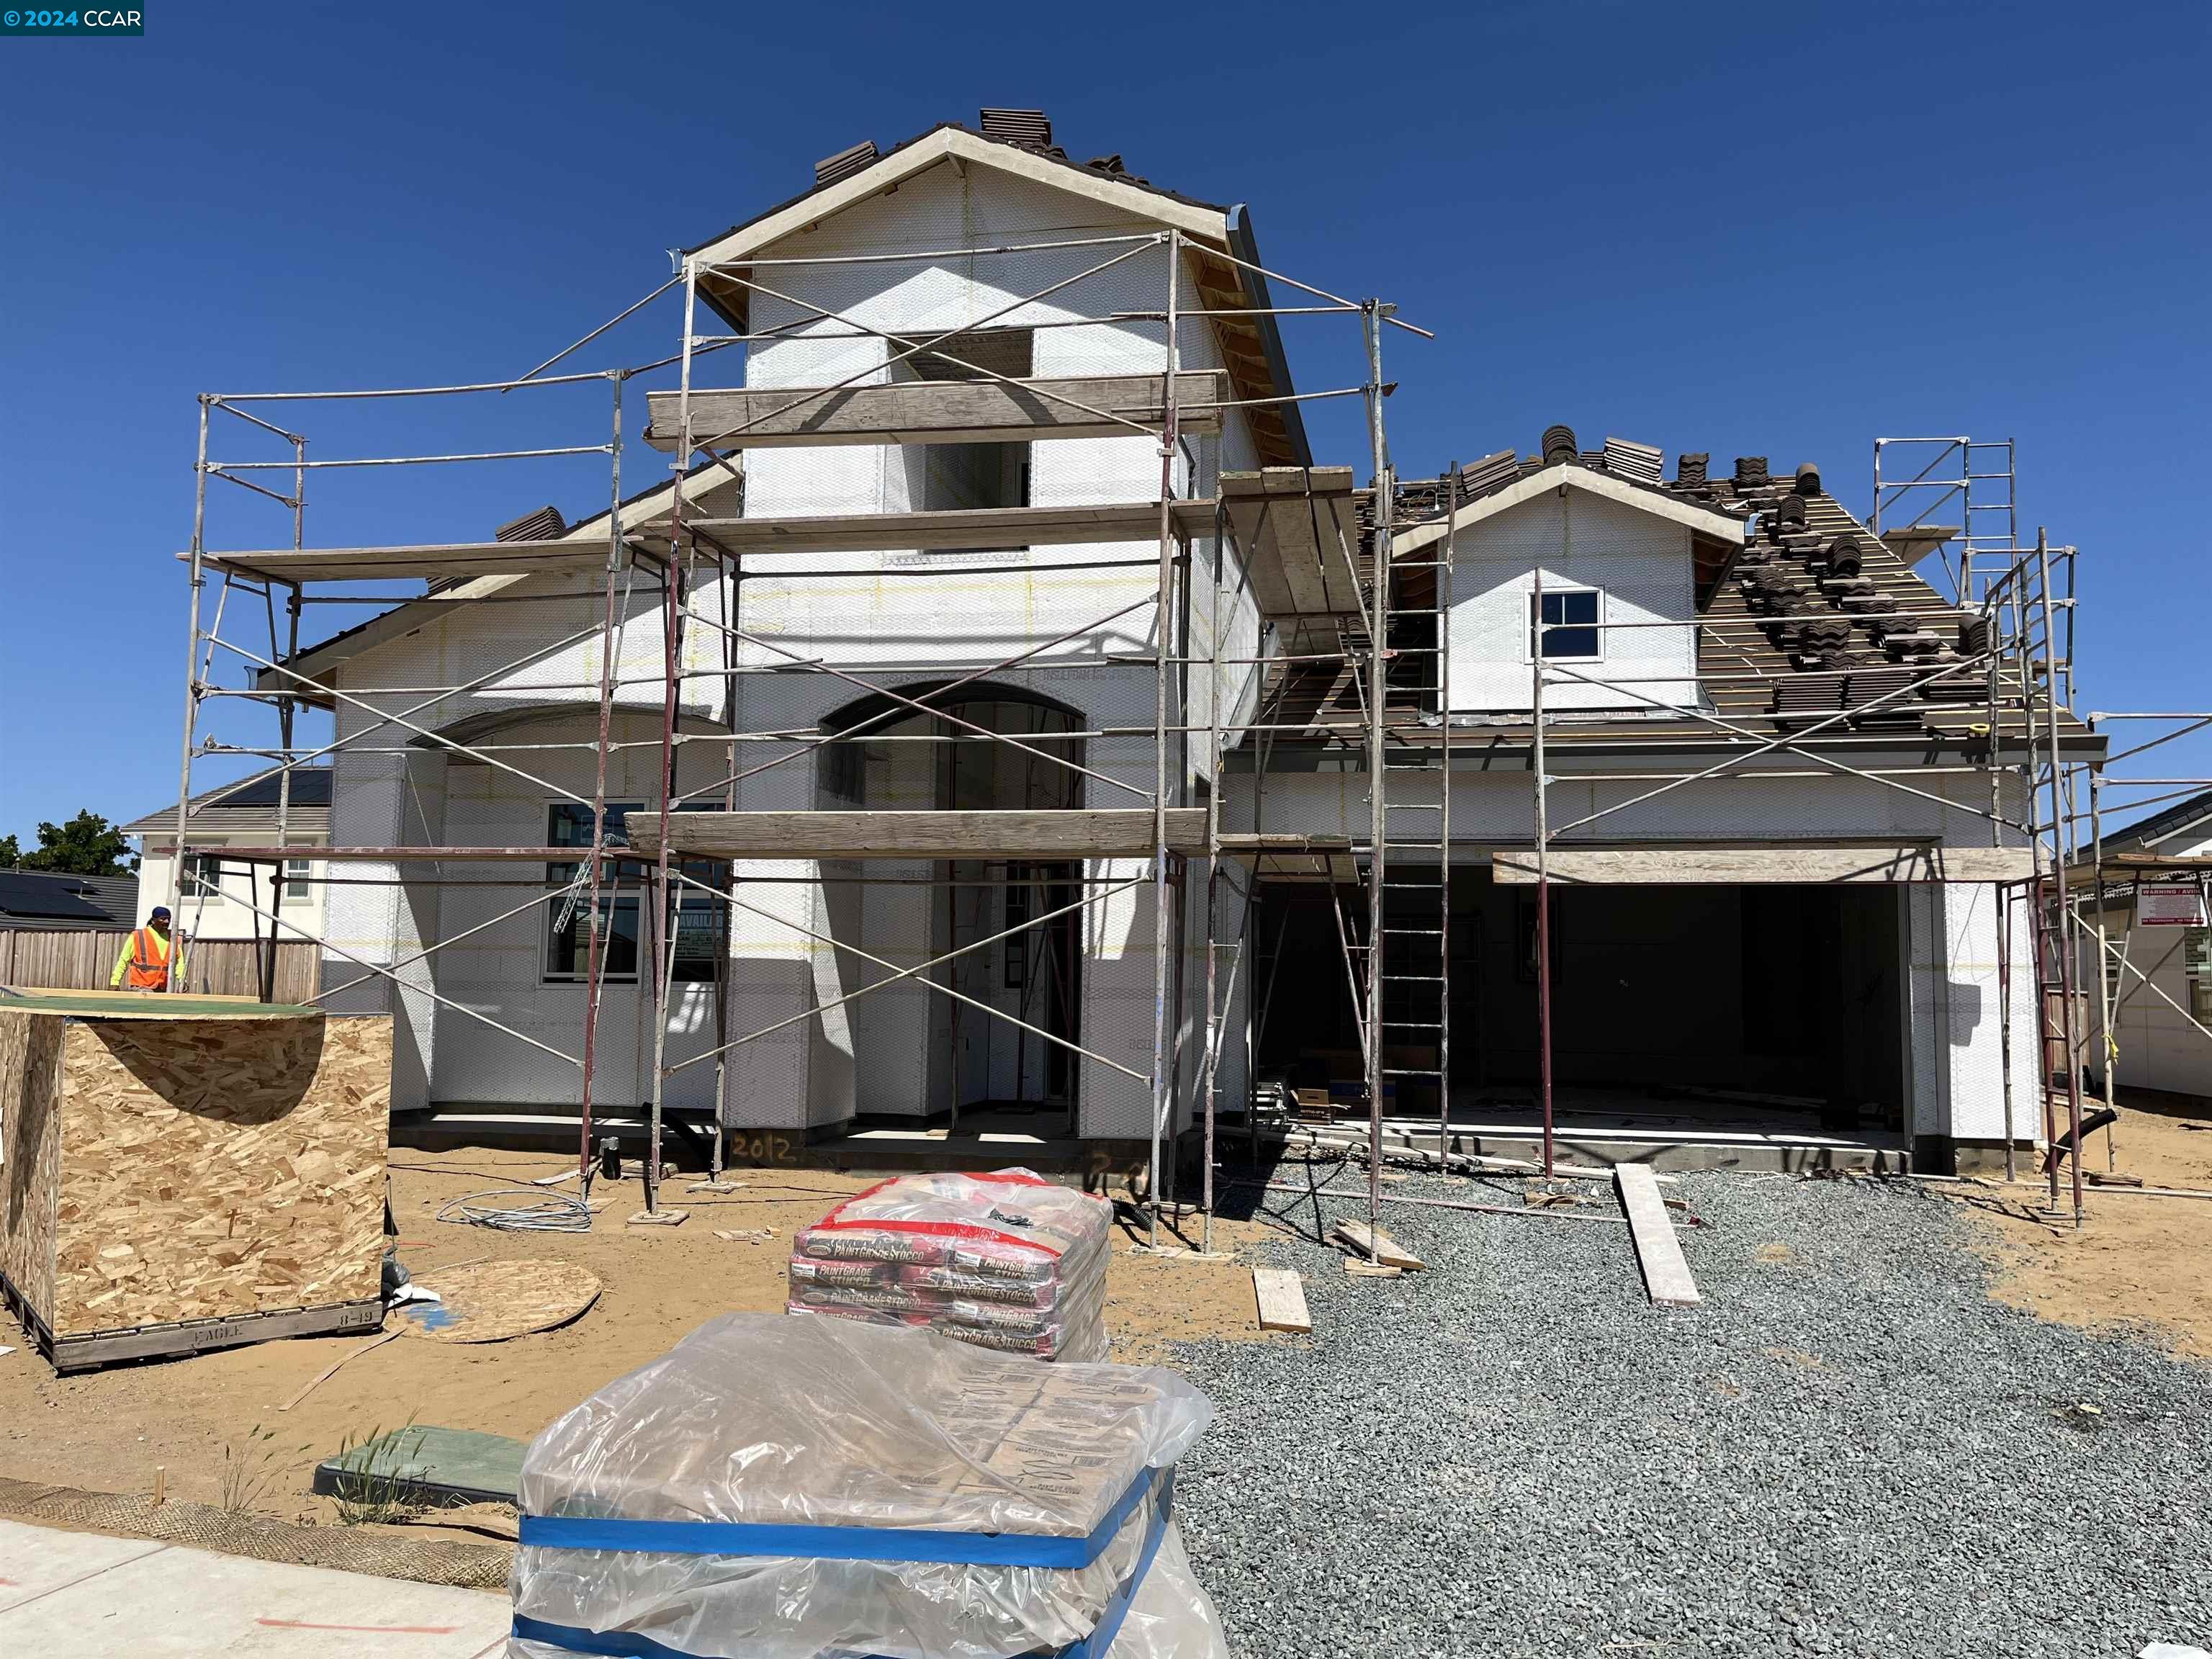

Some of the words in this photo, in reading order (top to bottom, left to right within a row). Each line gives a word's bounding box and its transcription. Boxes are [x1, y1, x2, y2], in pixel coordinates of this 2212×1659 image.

[732, 1133, 797, 1162] 2012
[830, 1276, 871, 1287] STUCCO
[994, 1269, 1037, 1281] STUCCO
[340, 1311, 373, 1326] 8-19
[991, 1318, 1034, 1332] STUCCO
[194, 1324, 243, 1343] EAGLE
